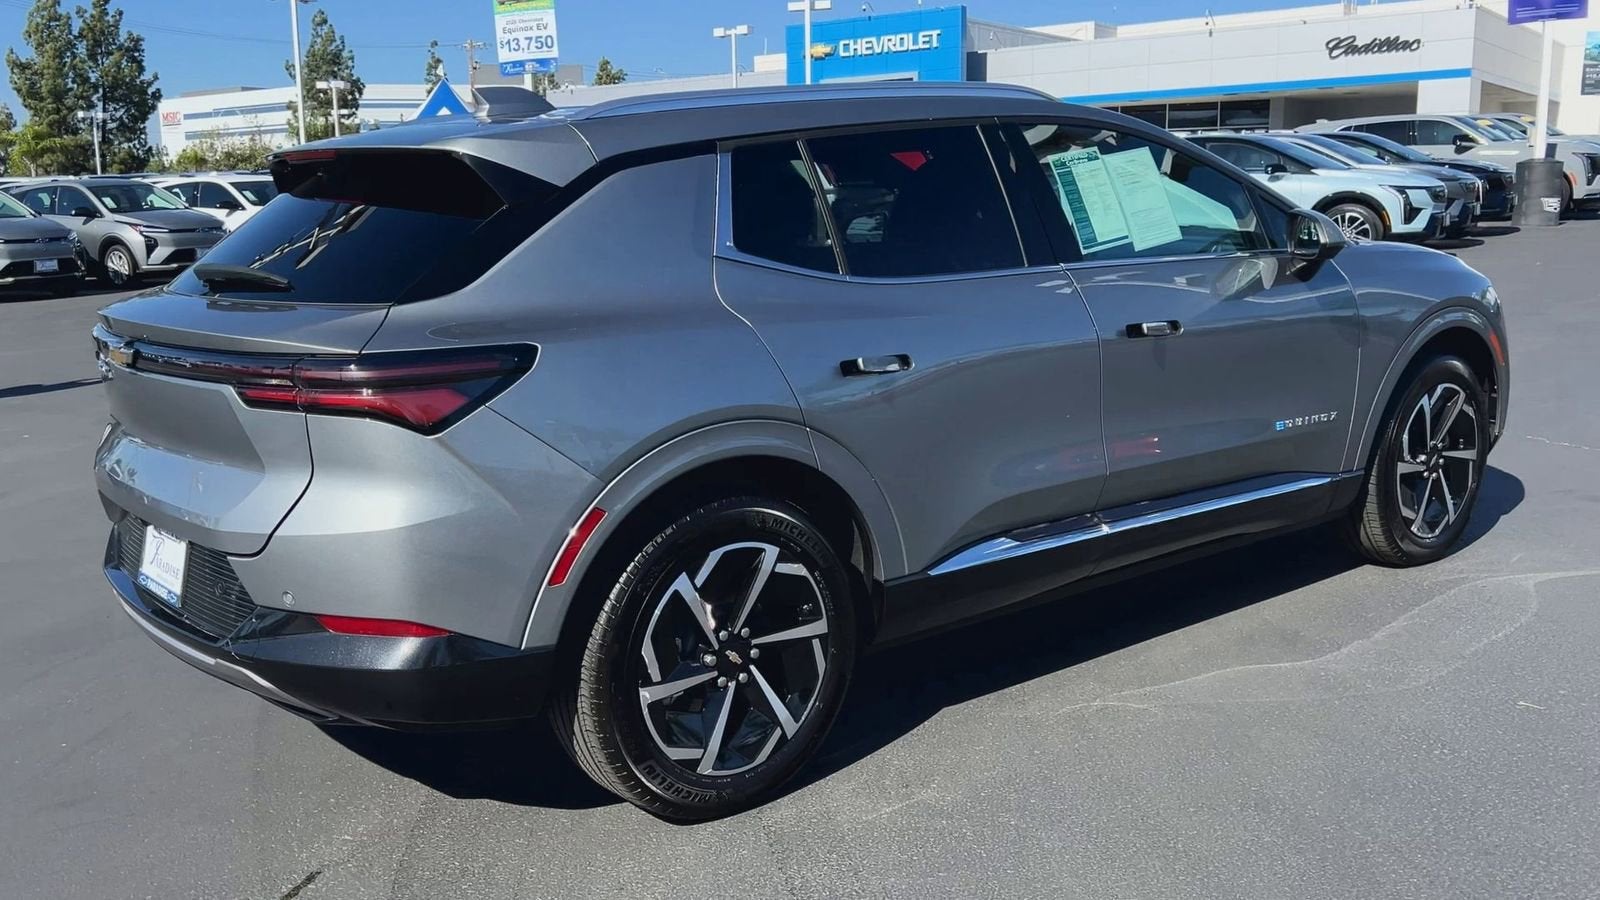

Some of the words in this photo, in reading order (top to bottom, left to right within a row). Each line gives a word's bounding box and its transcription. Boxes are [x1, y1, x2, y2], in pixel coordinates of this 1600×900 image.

[502, 25, 534, 35] Equinox
[535, 22, 549, 31] EV
[500, 34, 554, 53] $13,750
[838, 29, 941, 58] CHEVROLET
[1325, 35, 1421, 60] Cadillac
[1276, 411, 1338, 431] EQUINOX
